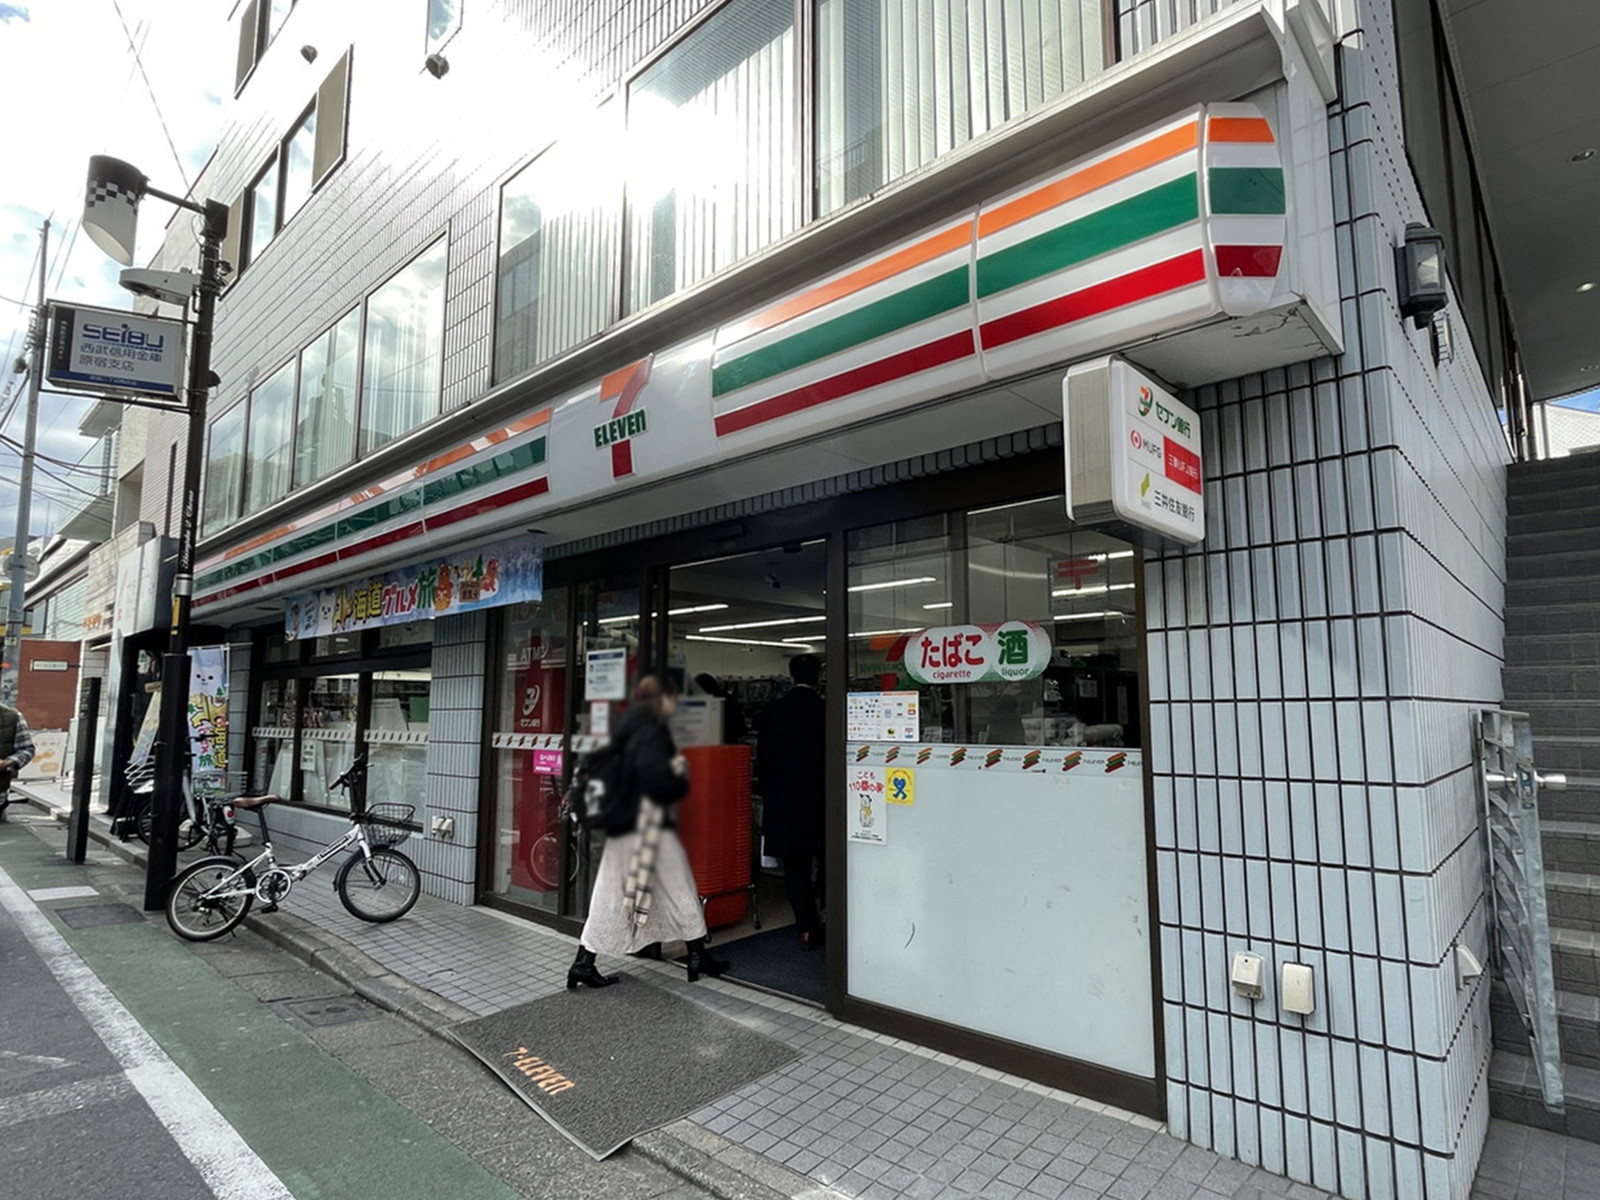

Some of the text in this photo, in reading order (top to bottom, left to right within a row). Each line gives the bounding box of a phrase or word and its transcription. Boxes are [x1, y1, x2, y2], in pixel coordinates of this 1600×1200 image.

[79, 354, 135, 372] 原宿支店
[80, 342, 162, 363] 西武信用金庫
[1155, 401, 1191, 439] セブン銀行
[1142, 438, 1162, 459] MUFG
[1154, 490, 1195, 522] 三井住友銀行
[921, 630, 1028, 668] たばこ 酒
[932, 667, 1029, 680] cigarette liquor
[858, 771, 876, 780] こども
